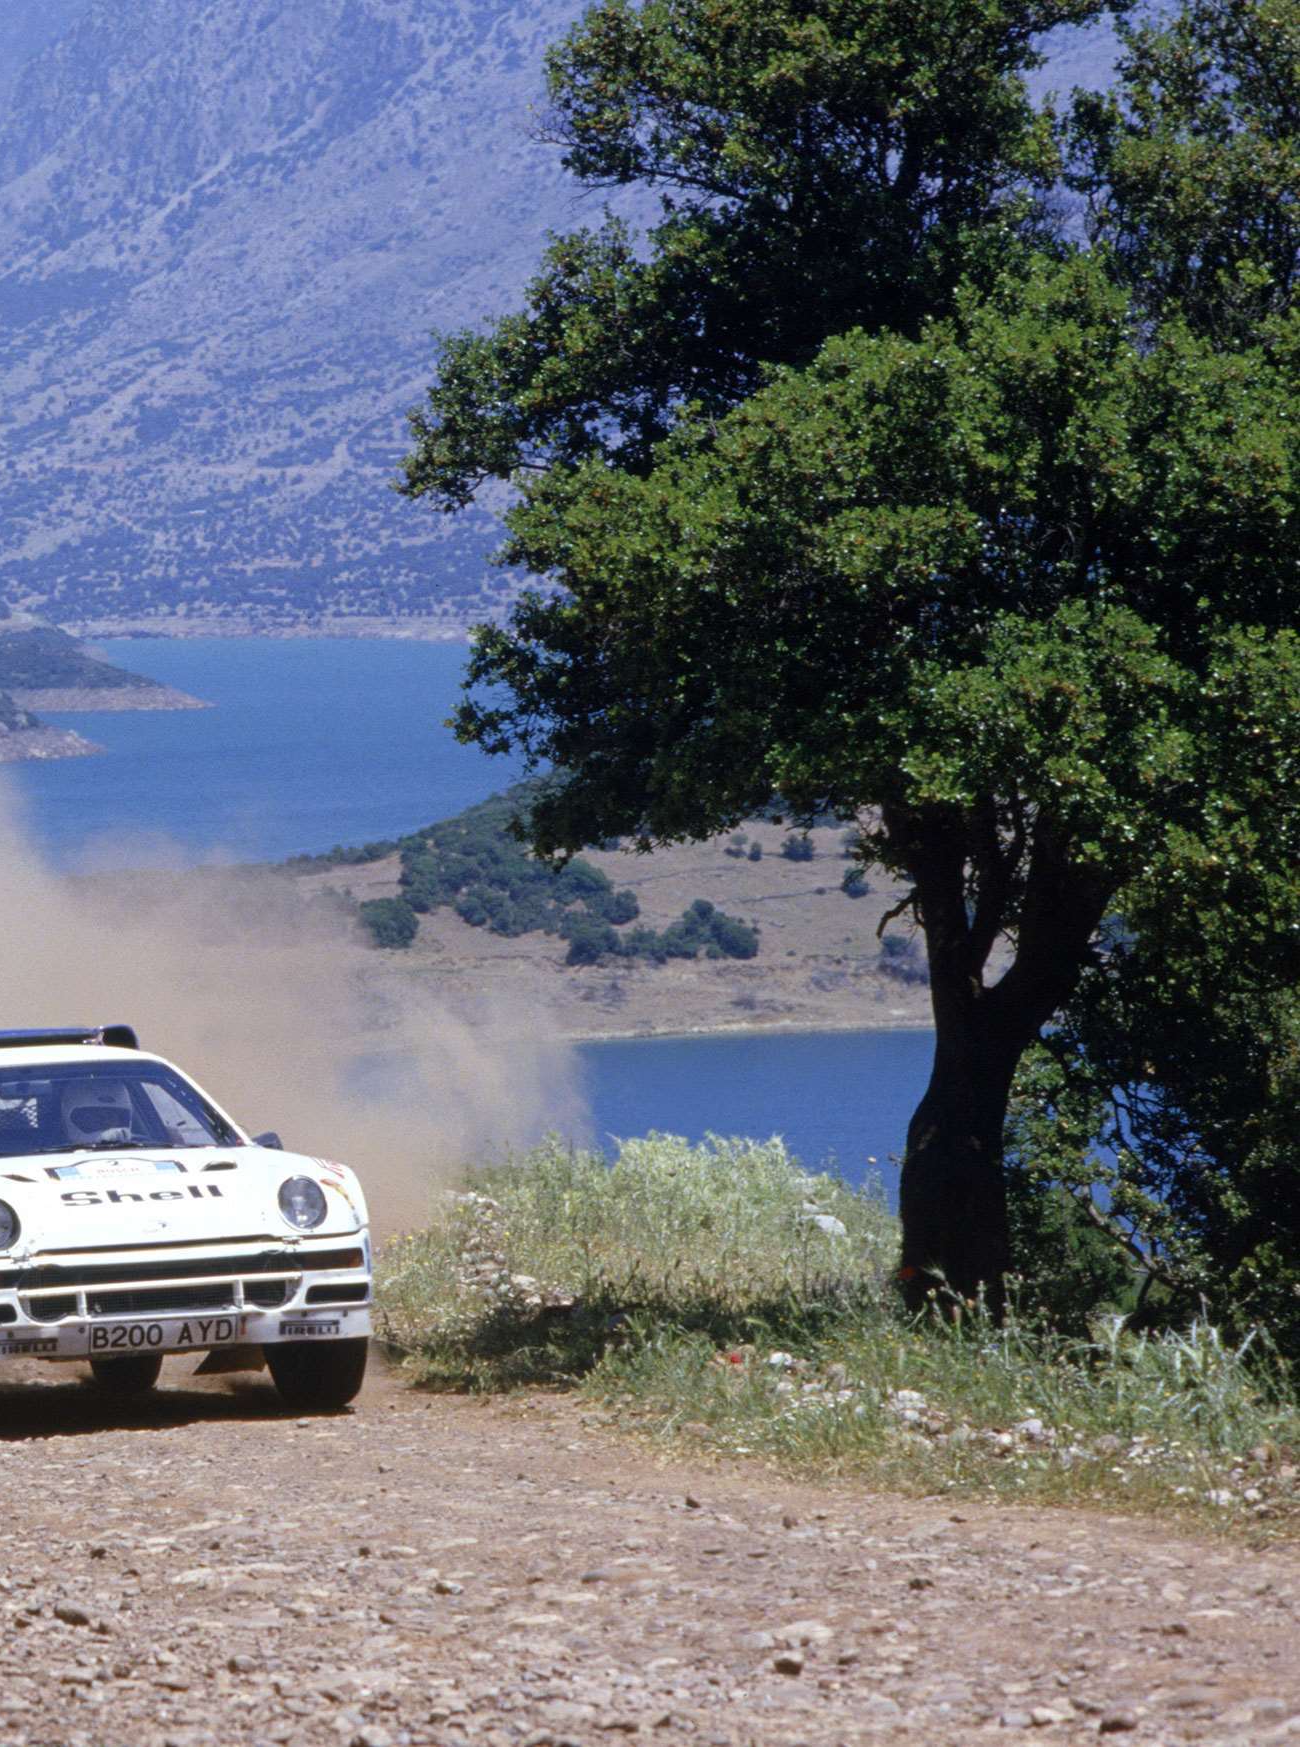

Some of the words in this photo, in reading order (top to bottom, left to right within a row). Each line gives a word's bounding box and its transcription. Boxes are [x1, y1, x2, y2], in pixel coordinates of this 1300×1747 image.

[60, 1185, 223, 1206] Shell
[92, 1323, 163, 1349] B200
[177, 1319, 233, 1345] AYD
